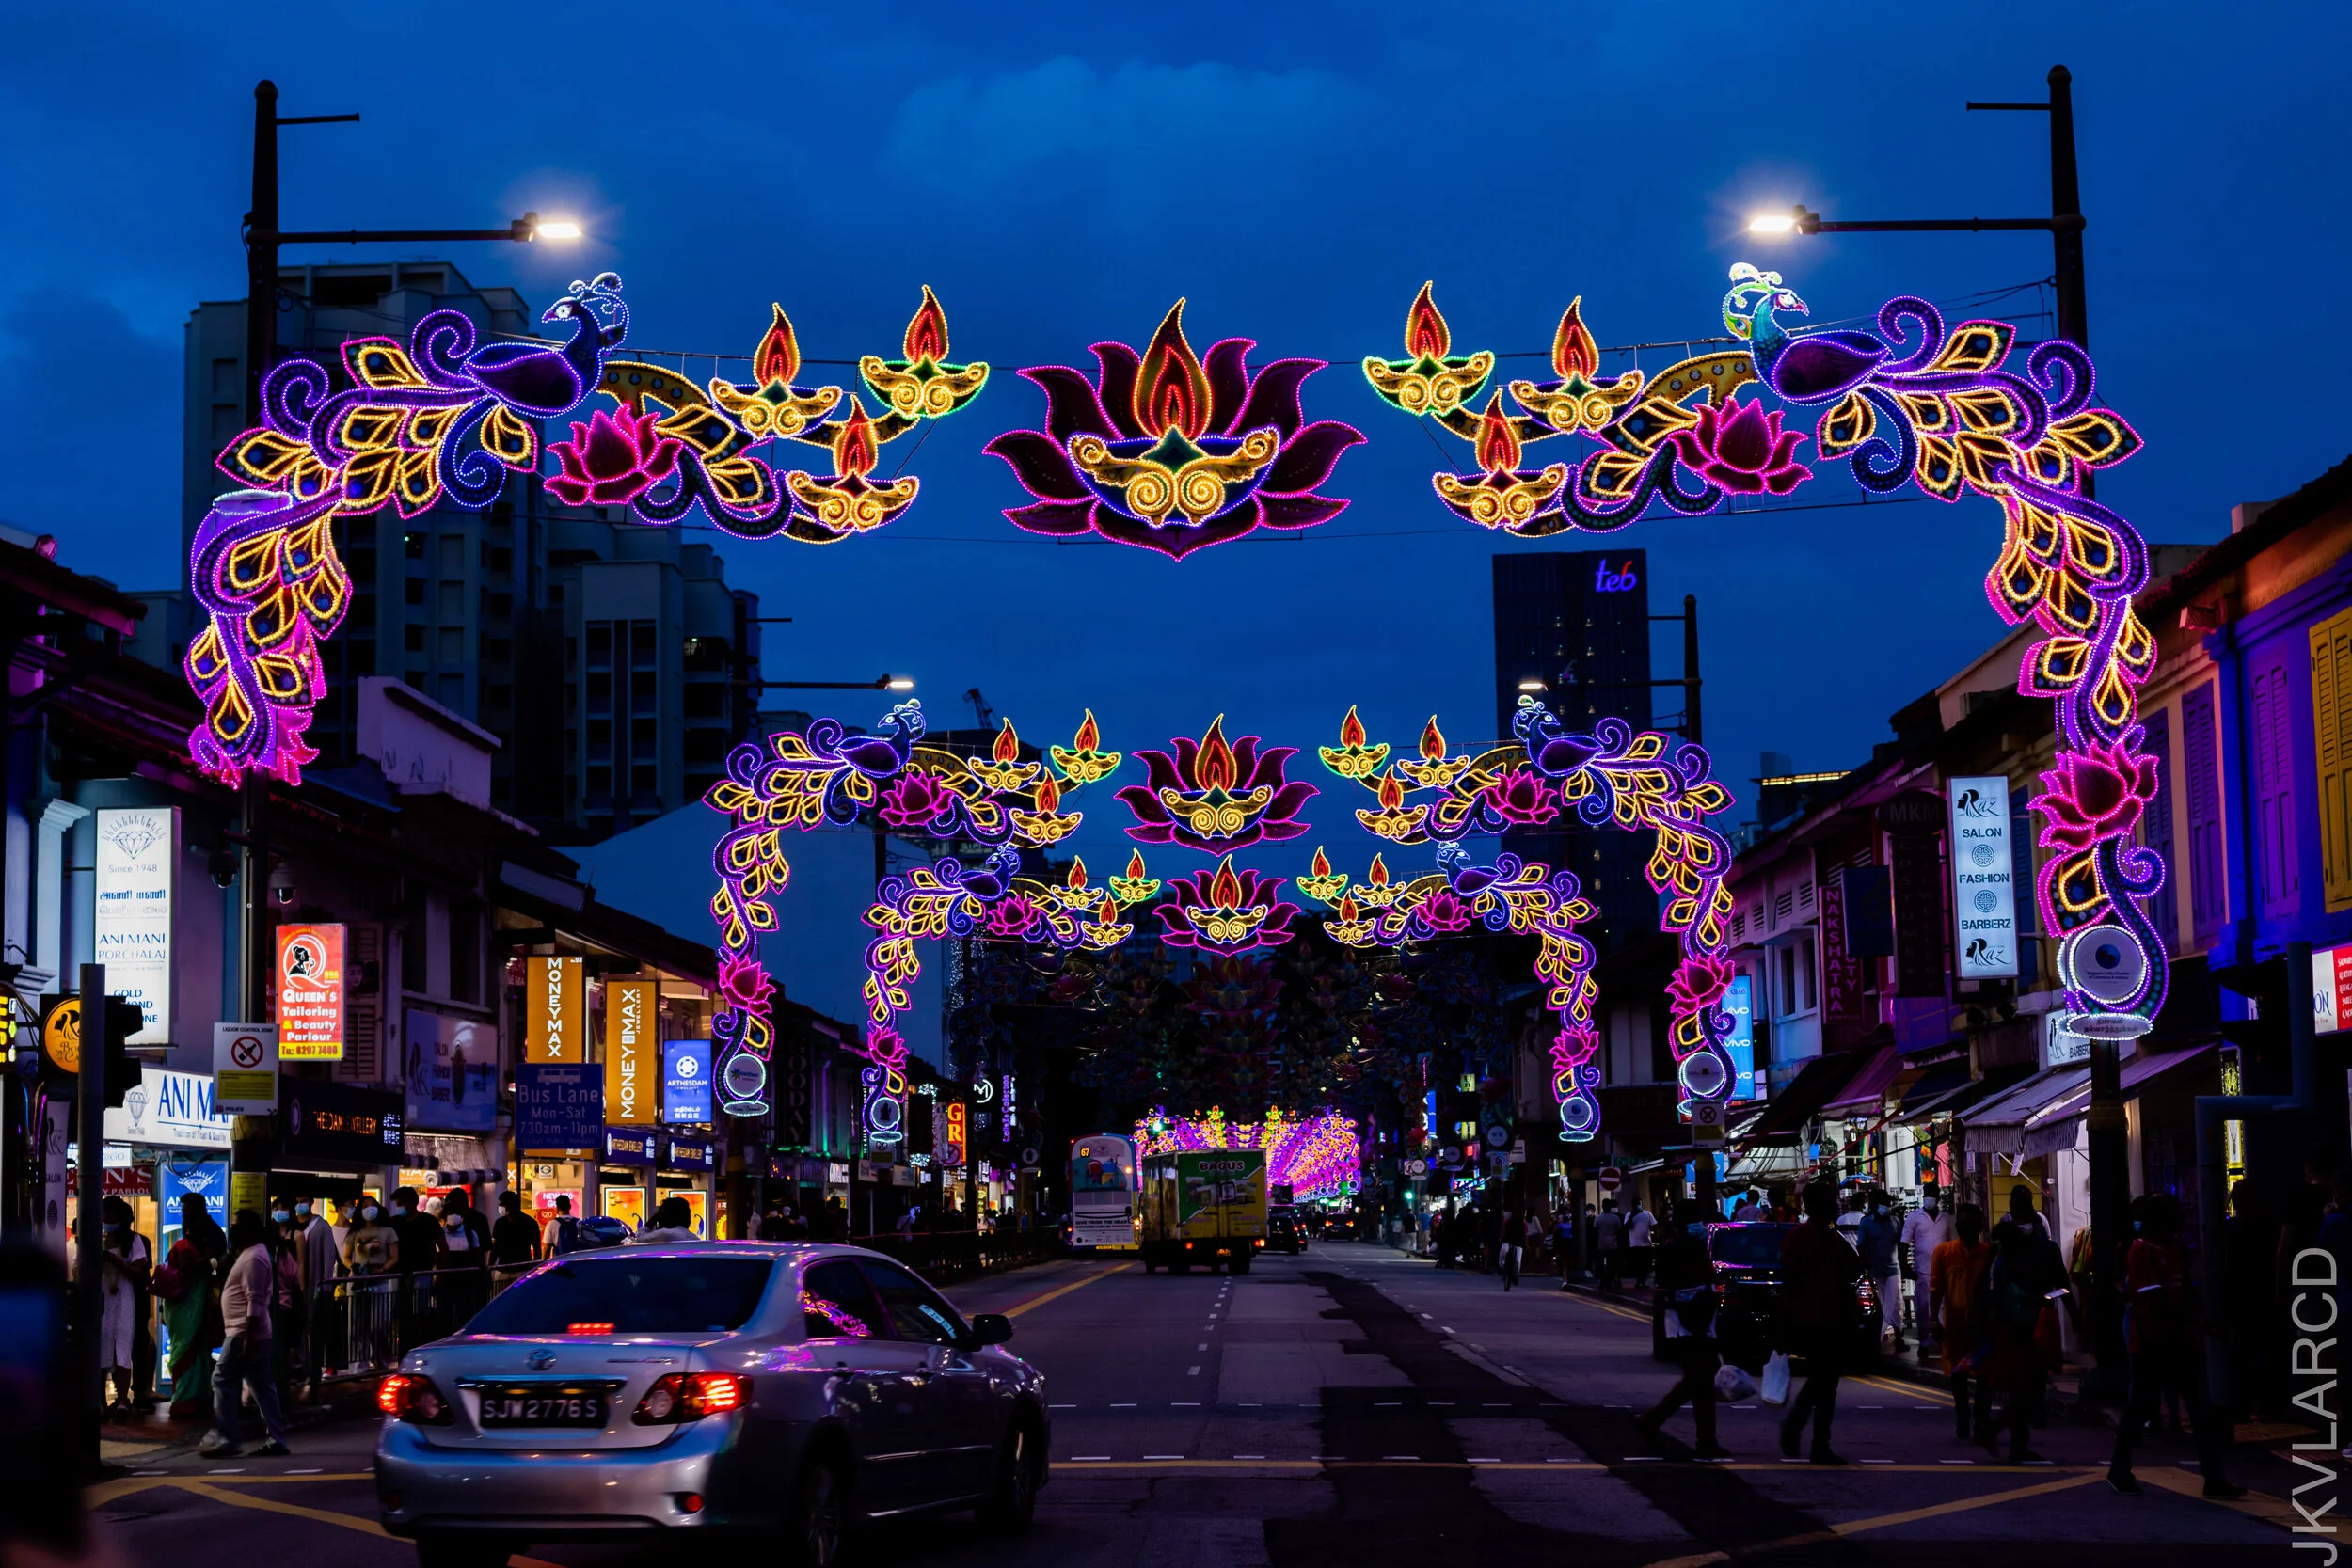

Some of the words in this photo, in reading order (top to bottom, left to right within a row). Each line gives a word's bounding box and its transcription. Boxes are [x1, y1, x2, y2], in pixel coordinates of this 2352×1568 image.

[1890, 803, 1940, 823] MKM
[1963, 828, 2002, 838] SALON
[136, 864, 158, 873] 1948
[1959, 873, 2010, 883] FASHION
[1961, 919, 2011, 929] BARBERZ
[100, 934, 124, 944] ANI
[128, 933, 166, 944] MANI
[98, 950, 166, 959] PORCHALAI
[1825, 890, 1843, 1012] NAKSHATRA
[114, 990, 142, 998] GOLD
[282, 1006, 336, 1018] Tailoring
[548, 958, 562, 1057] MONEYMAX
[282, 1020, 292, 1030] &
[294, 1021, 336, 1031] Beauty
[287, 1032, 331, 1041] Parlour
[158, 1074, 191, 1119] ANI
[519, 1085, 550, 1103] Bus
[558, 1085, 598, 1103] Lane
[1080, 1148, 1090, 1157] 67
[1199, 1161, 1246, 1171] BAGUS
